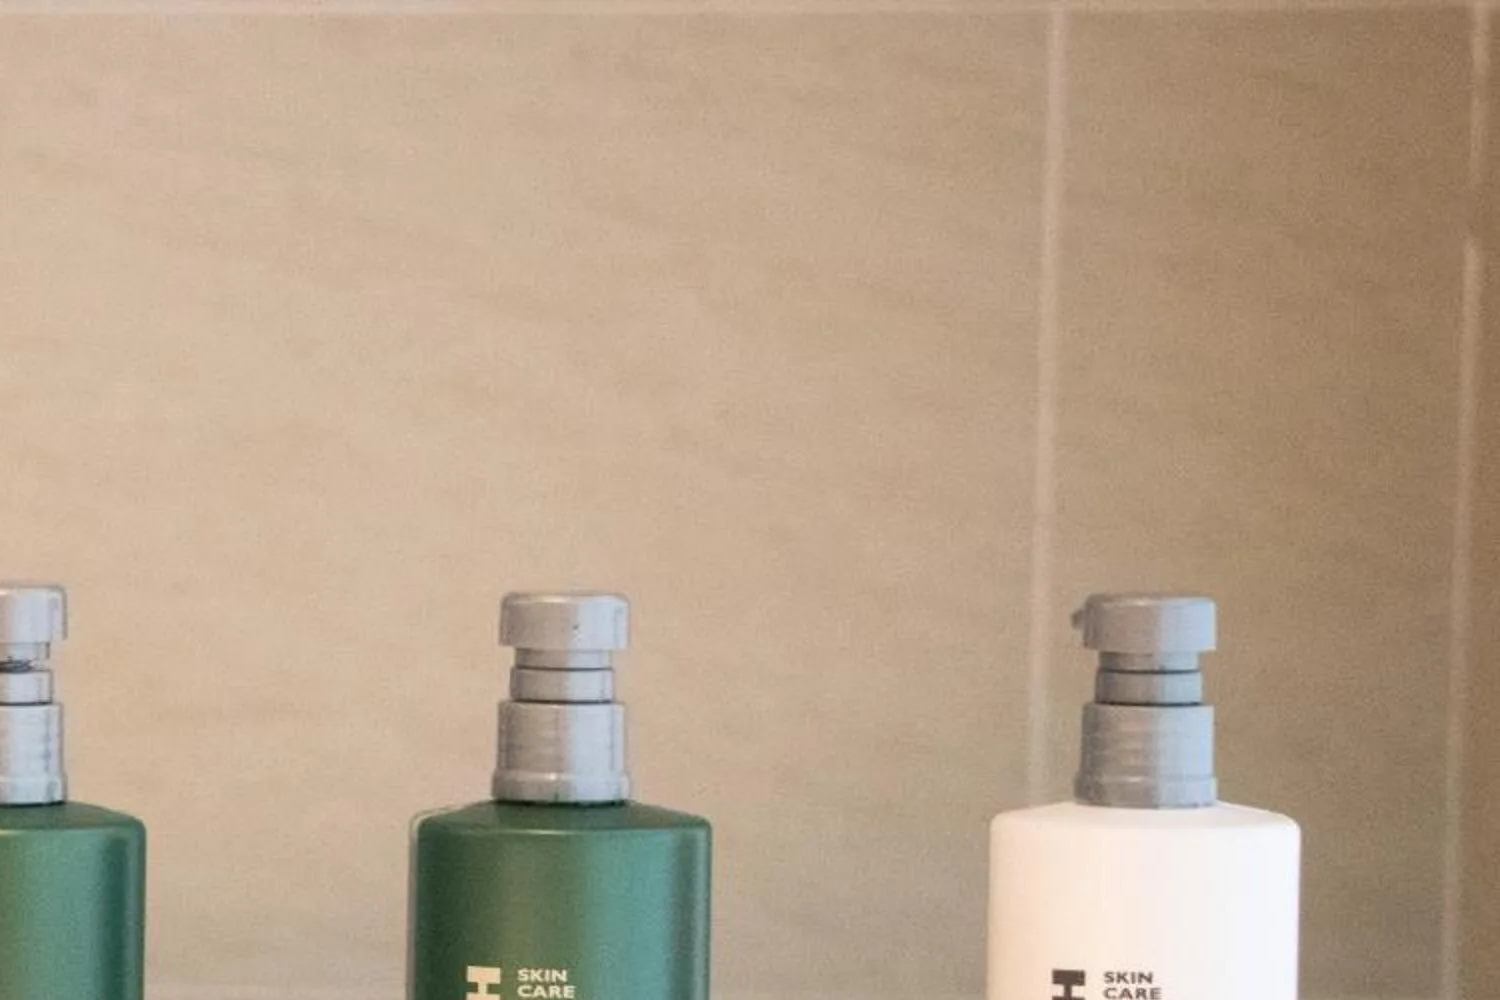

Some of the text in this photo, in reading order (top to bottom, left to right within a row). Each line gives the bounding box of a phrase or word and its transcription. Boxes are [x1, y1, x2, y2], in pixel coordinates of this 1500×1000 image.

[517, 968, 567, 982] SKIN
[1103, 971, 1153, 985] SKIN
[517, 985, 575, 999] CARE
[1103, 987, 1162, 1000] CARE
